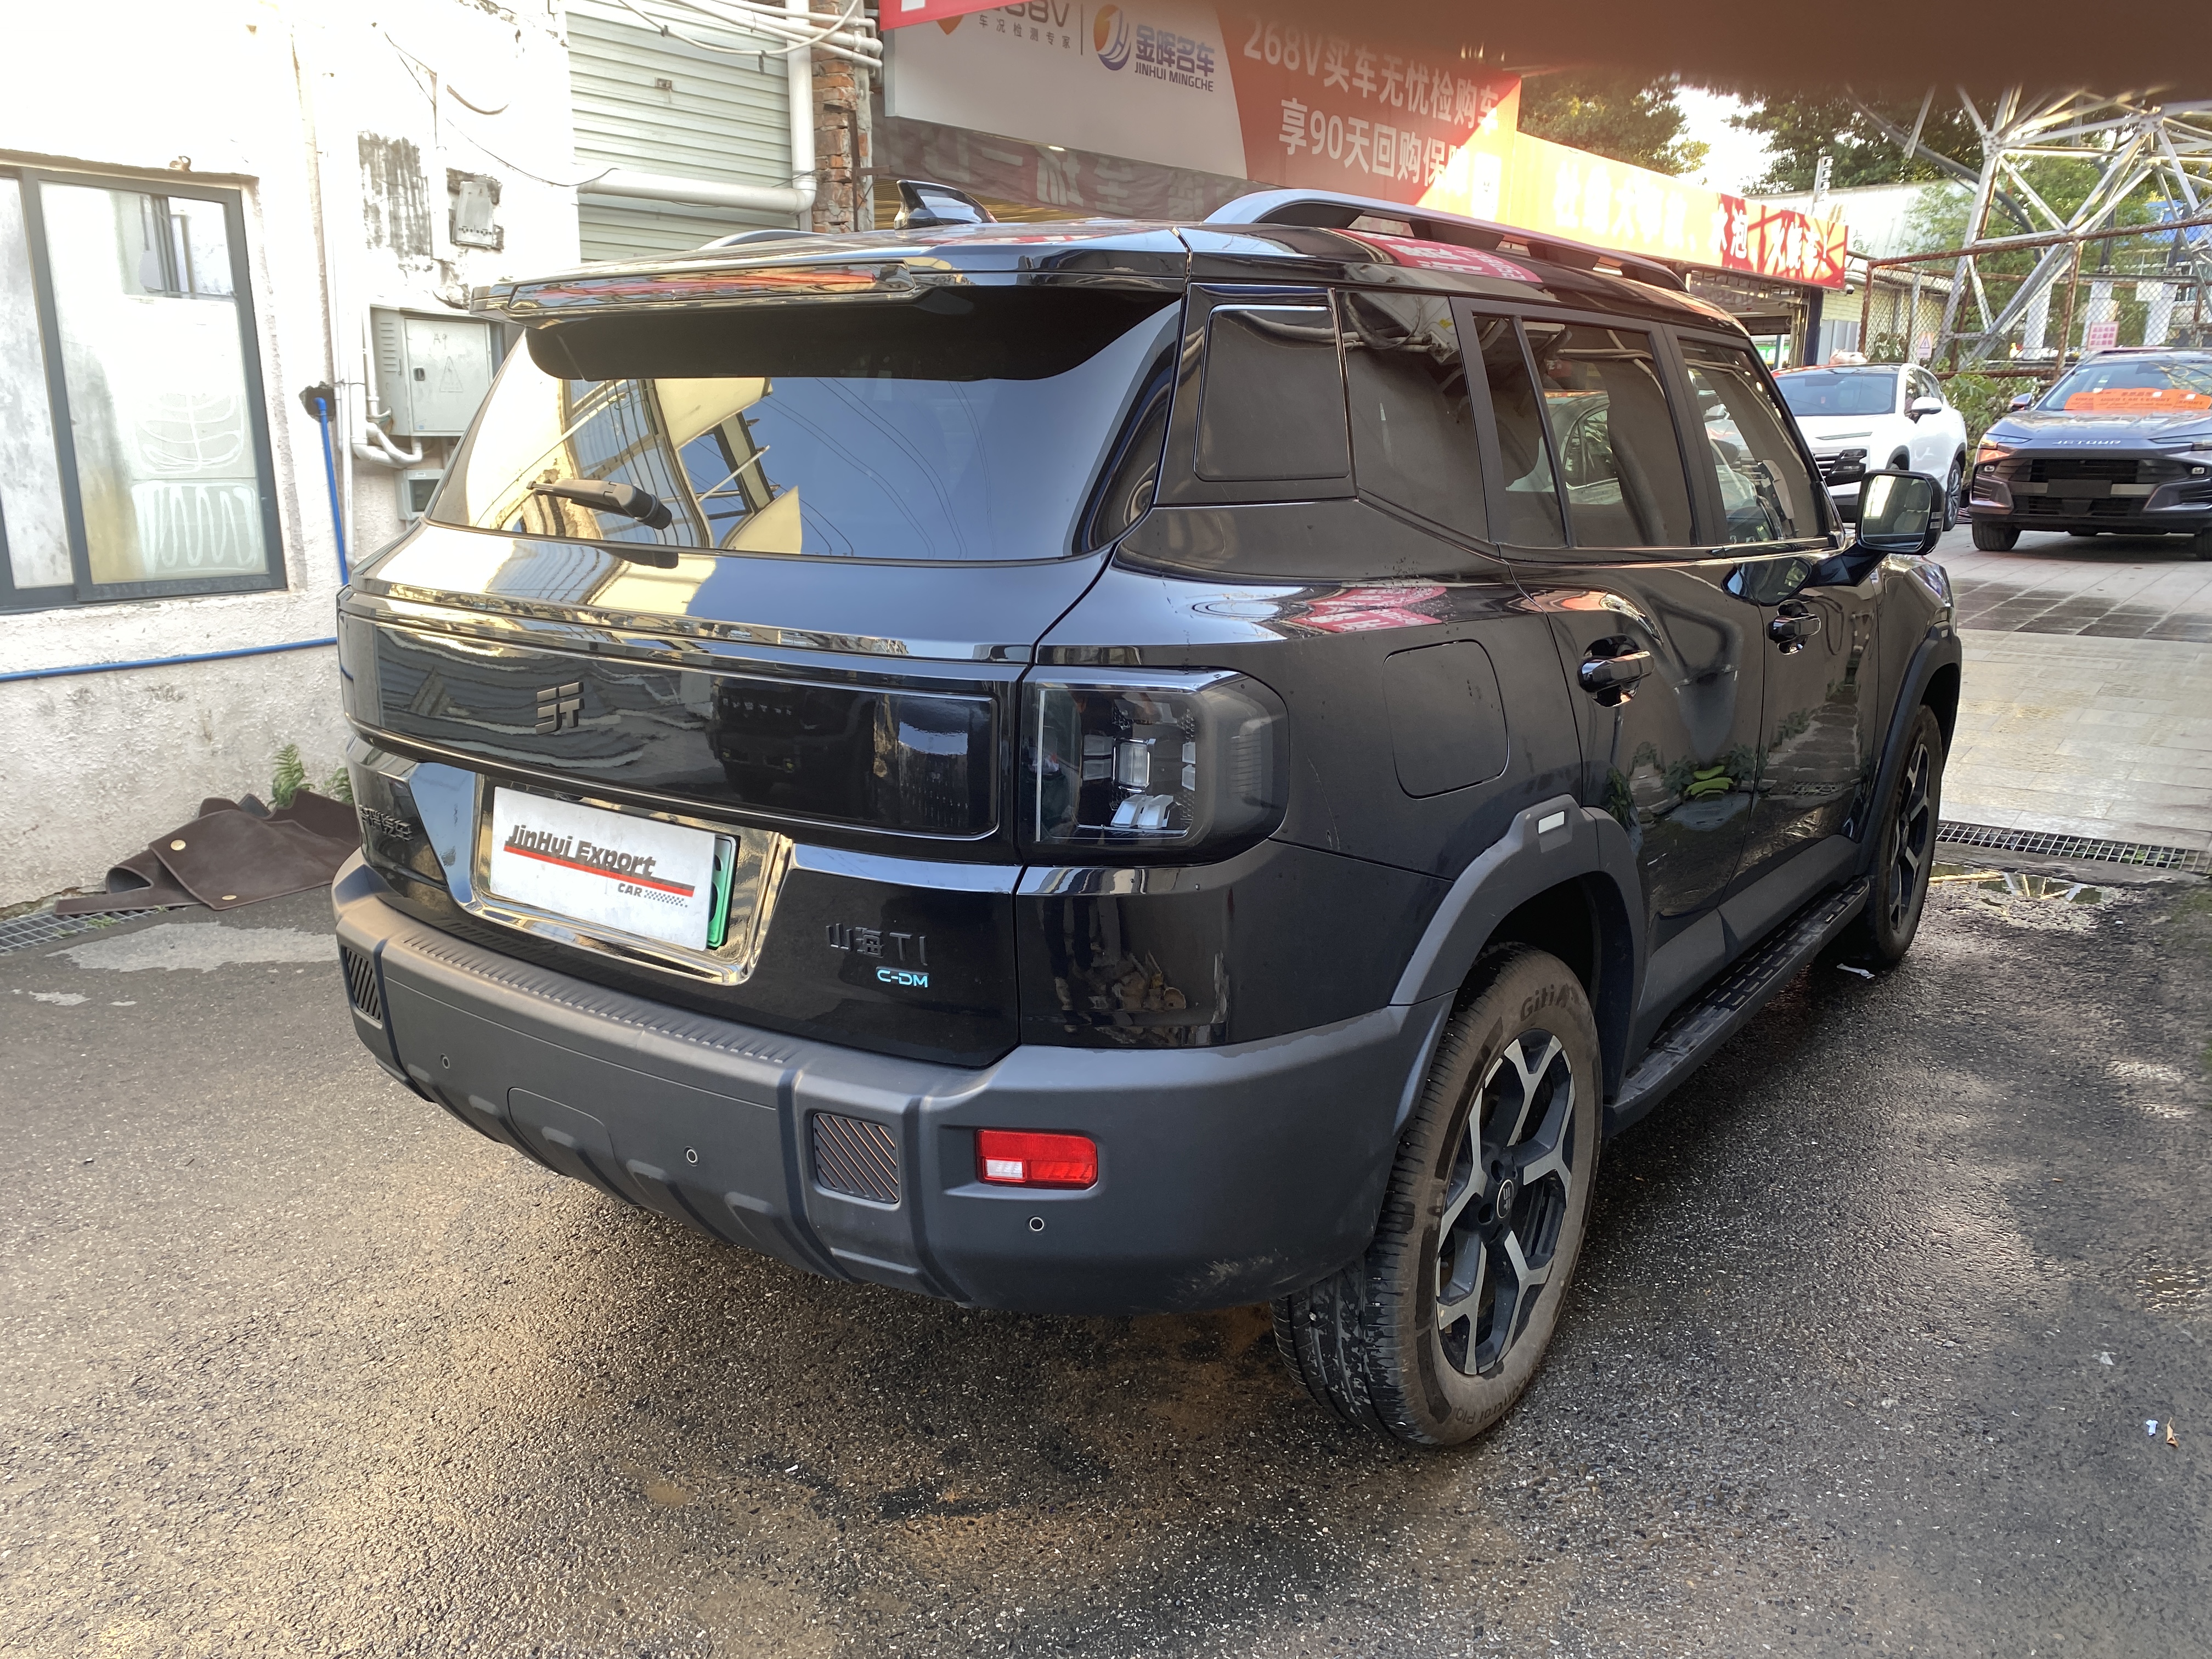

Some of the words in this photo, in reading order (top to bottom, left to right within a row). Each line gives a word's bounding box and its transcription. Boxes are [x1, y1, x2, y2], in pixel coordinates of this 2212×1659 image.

[979, 14, 1071, 49] 车况检测专家
[1135, 24, 1215, 77] 金晖名车
[1135, 61, 1166, 81] JINHUI
[1169, 70, 1214, 92] MINGCHE
[1279, 98, 1470, 196] 享90天回购保
[505, 825, 574, 859] JinHui
[575, 840, 657, 878] Export
[617, 883, 642, 898] CAR
[877, 969, 929, 988] C-DM
